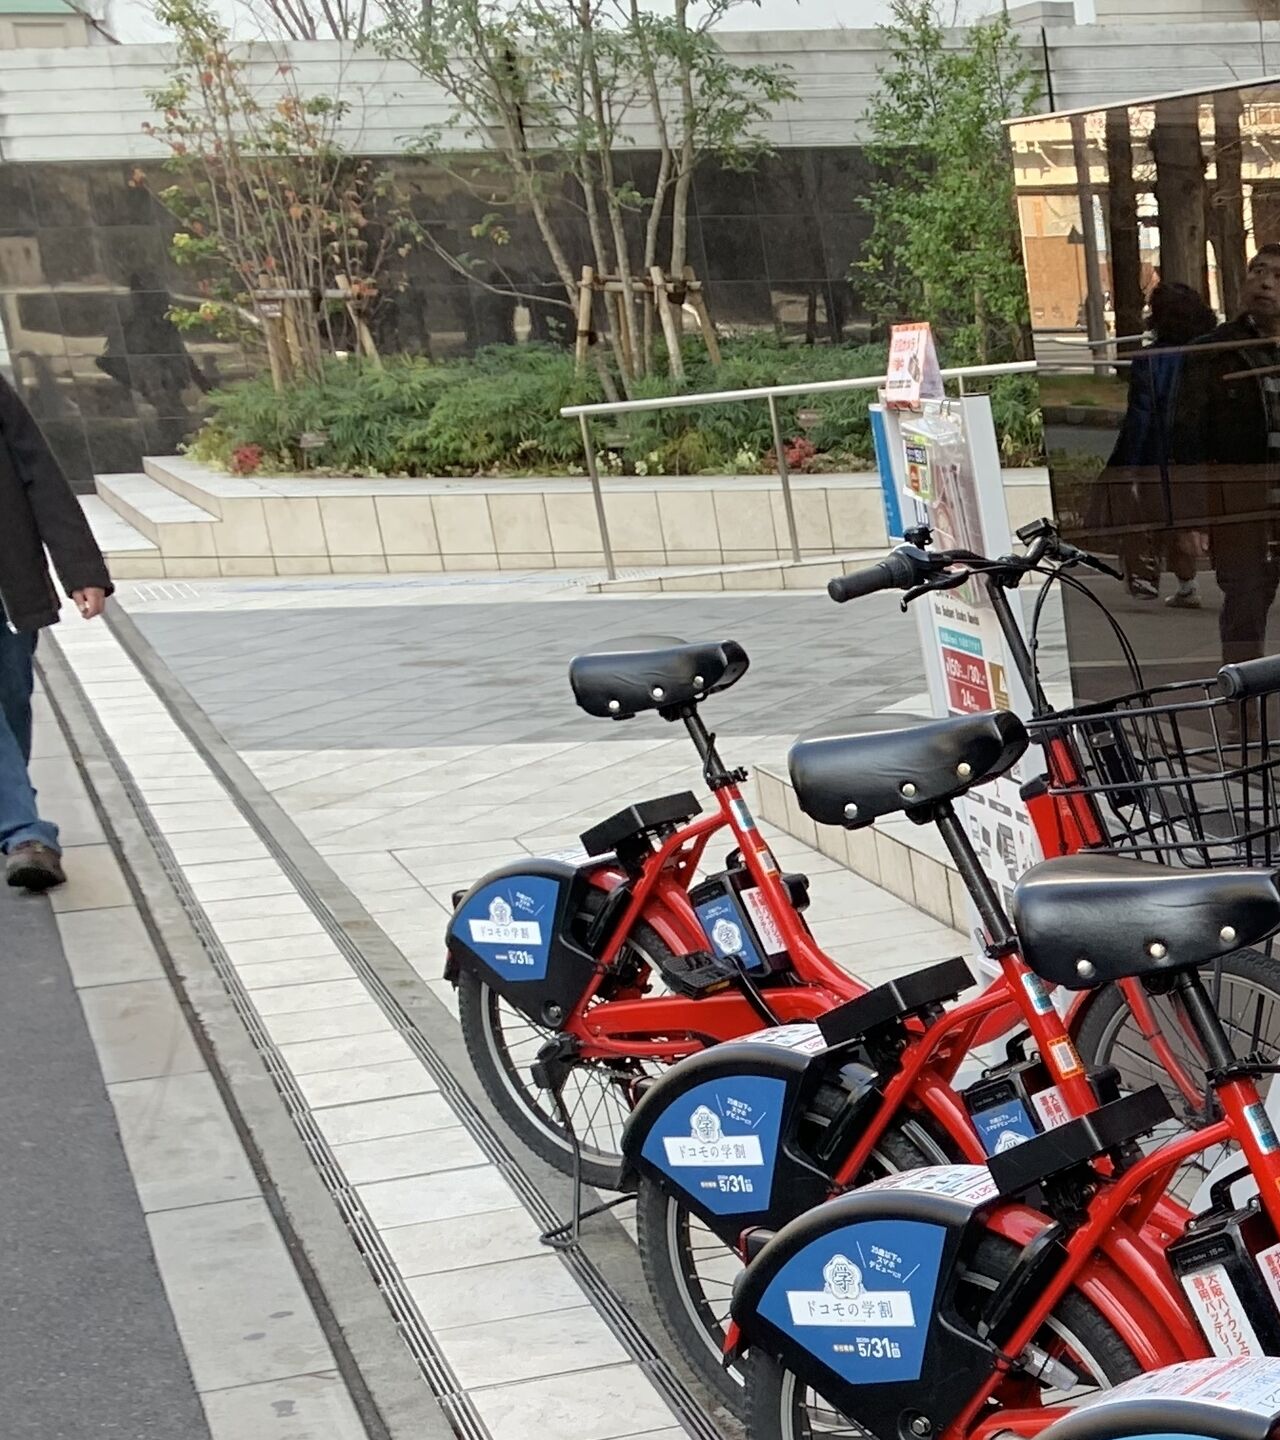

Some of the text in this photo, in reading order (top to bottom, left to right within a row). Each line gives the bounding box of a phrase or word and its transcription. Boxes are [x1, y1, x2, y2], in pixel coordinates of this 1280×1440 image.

[807, 1300, 893, 1319] ドコモの学割
[858, 1338, 891, 1358] 5/31
